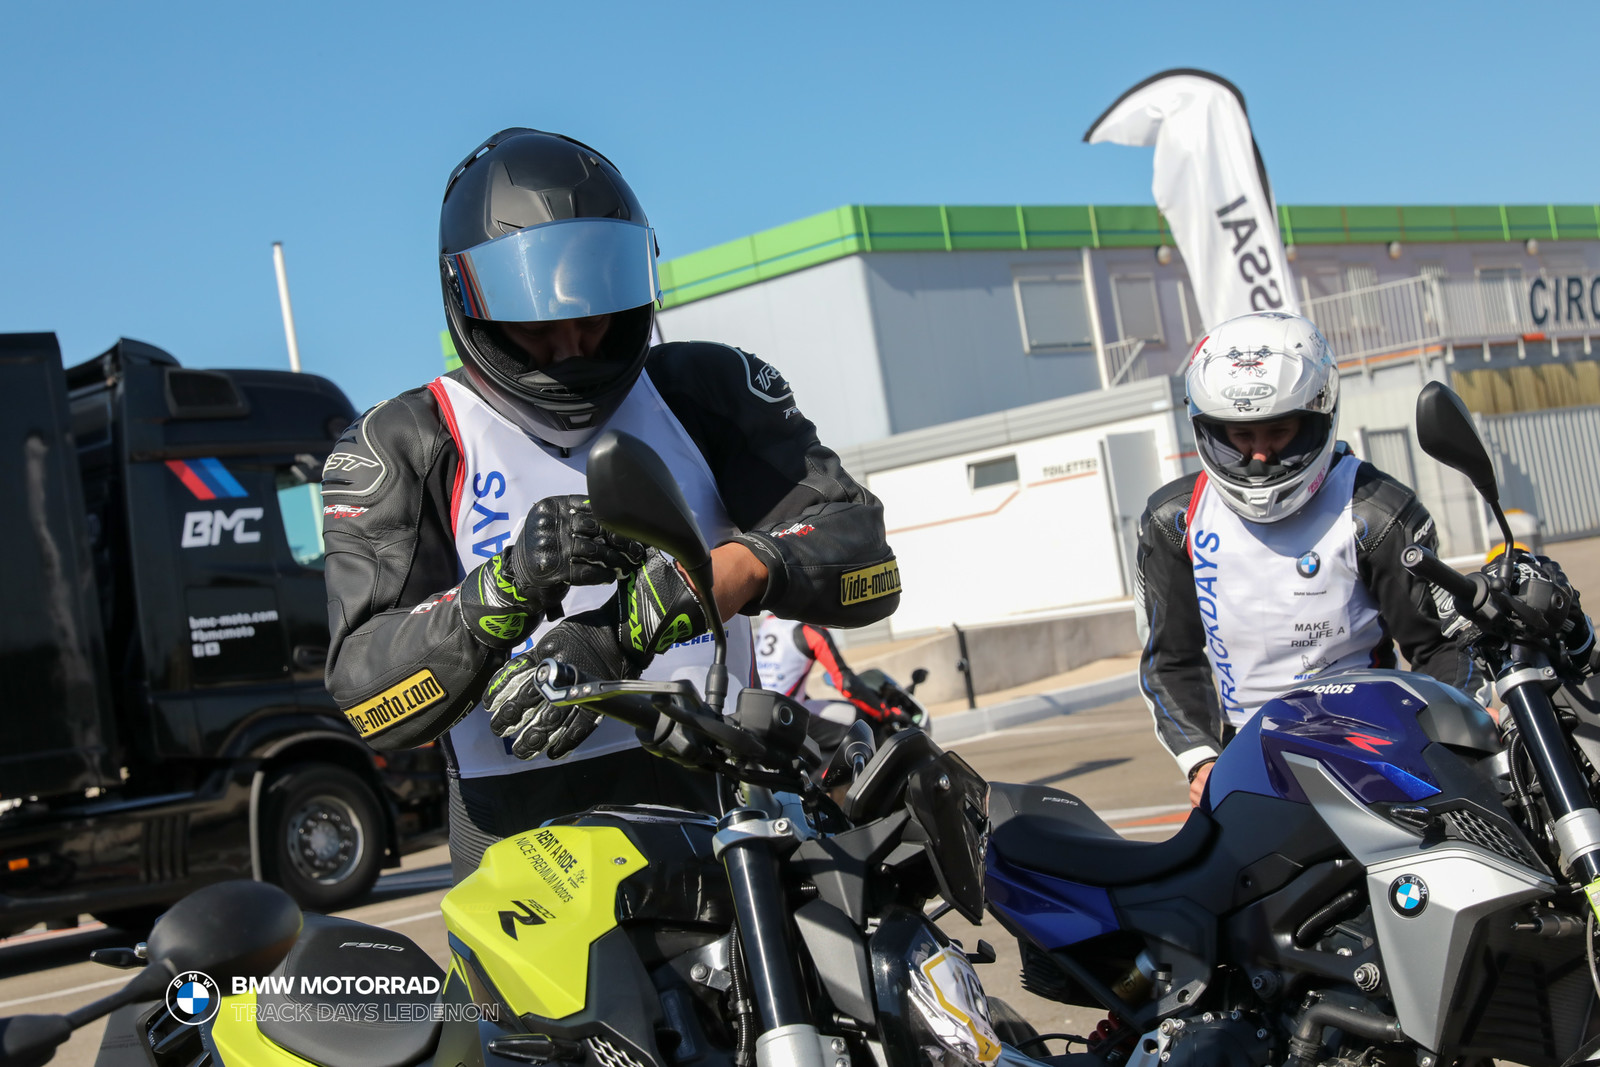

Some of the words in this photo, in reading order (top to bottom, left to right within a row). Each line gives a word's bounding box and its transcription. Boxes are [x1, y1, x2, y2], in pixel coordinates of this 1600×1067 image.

[1228, 386, 1270, 398] HJC
[181, 507, 264, 548] BMC
[1194, 529, 1245, 714] TRACKDAYS
[1294, 621, 1330, 632] MAKE
[1308, 629, 1333, 639] LIFE
[1337, 626, 1345, 635] A
[534, 829, 559, 853] RENT
[549, 844, 563, 859] A
[555, 848, 578, 874] RIDE
[514, 836, 537, 856] NICE
[527, 853, 560, 886] PREMIUM
[550, 879, 574, 903] Motors
[339, 941, 405, 952] F900
